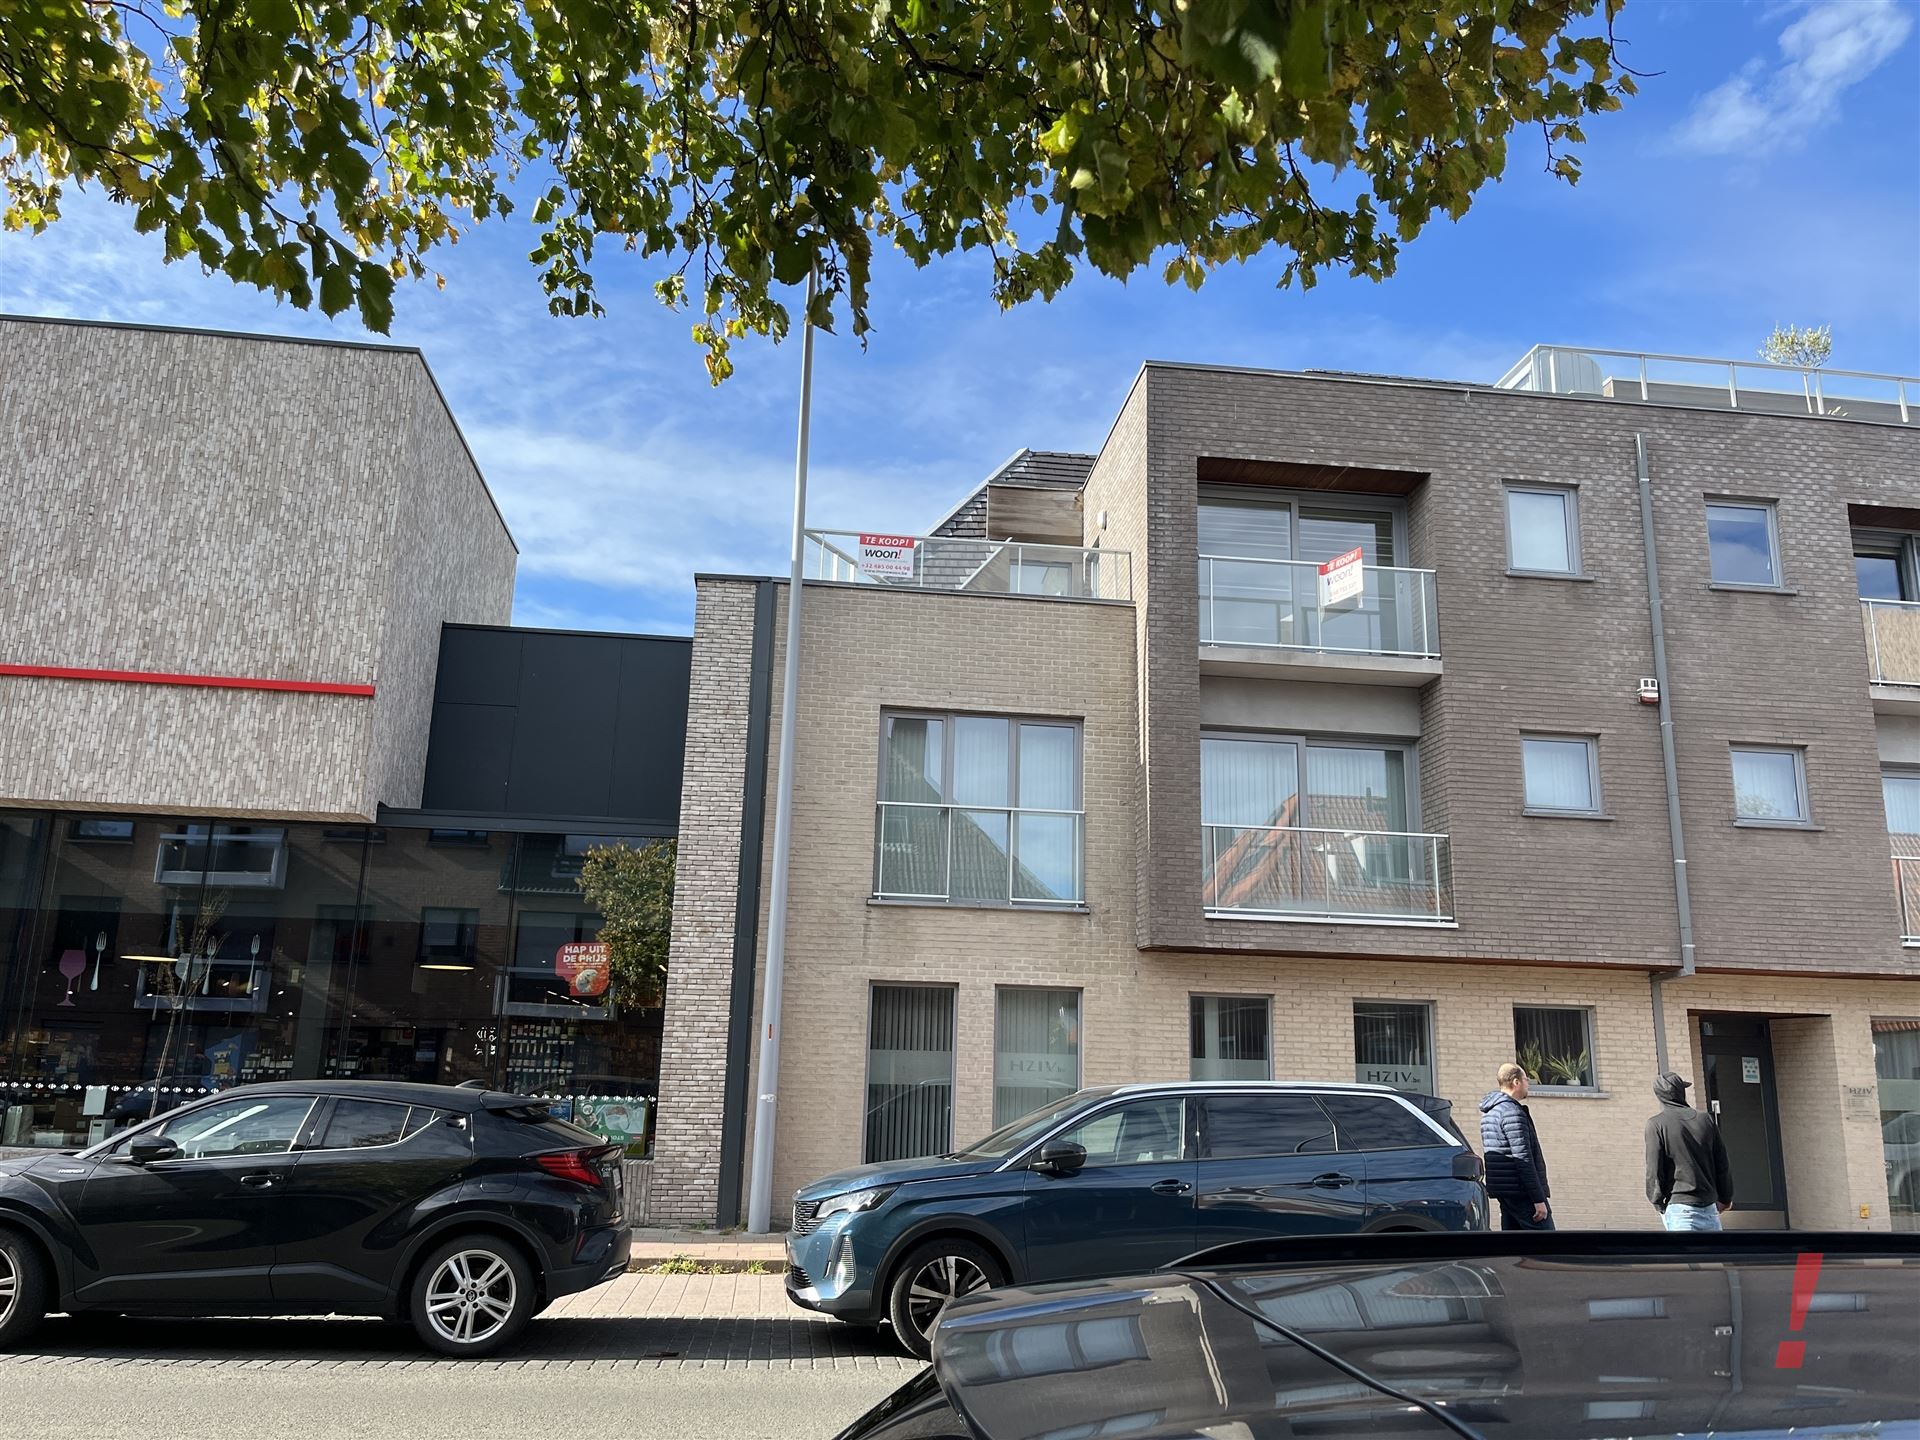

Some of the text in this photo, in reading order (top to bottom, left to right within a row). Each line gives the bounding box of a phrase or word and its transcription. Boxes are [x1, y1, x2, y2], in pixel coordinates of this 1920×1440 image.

[865, 536, 909, 546] TE KOOP!
[865, 549, 902, 559] woon!
[565, 945, 606, 954] HAP UIT
[563, 955, 607, 963] DE PRIJS
